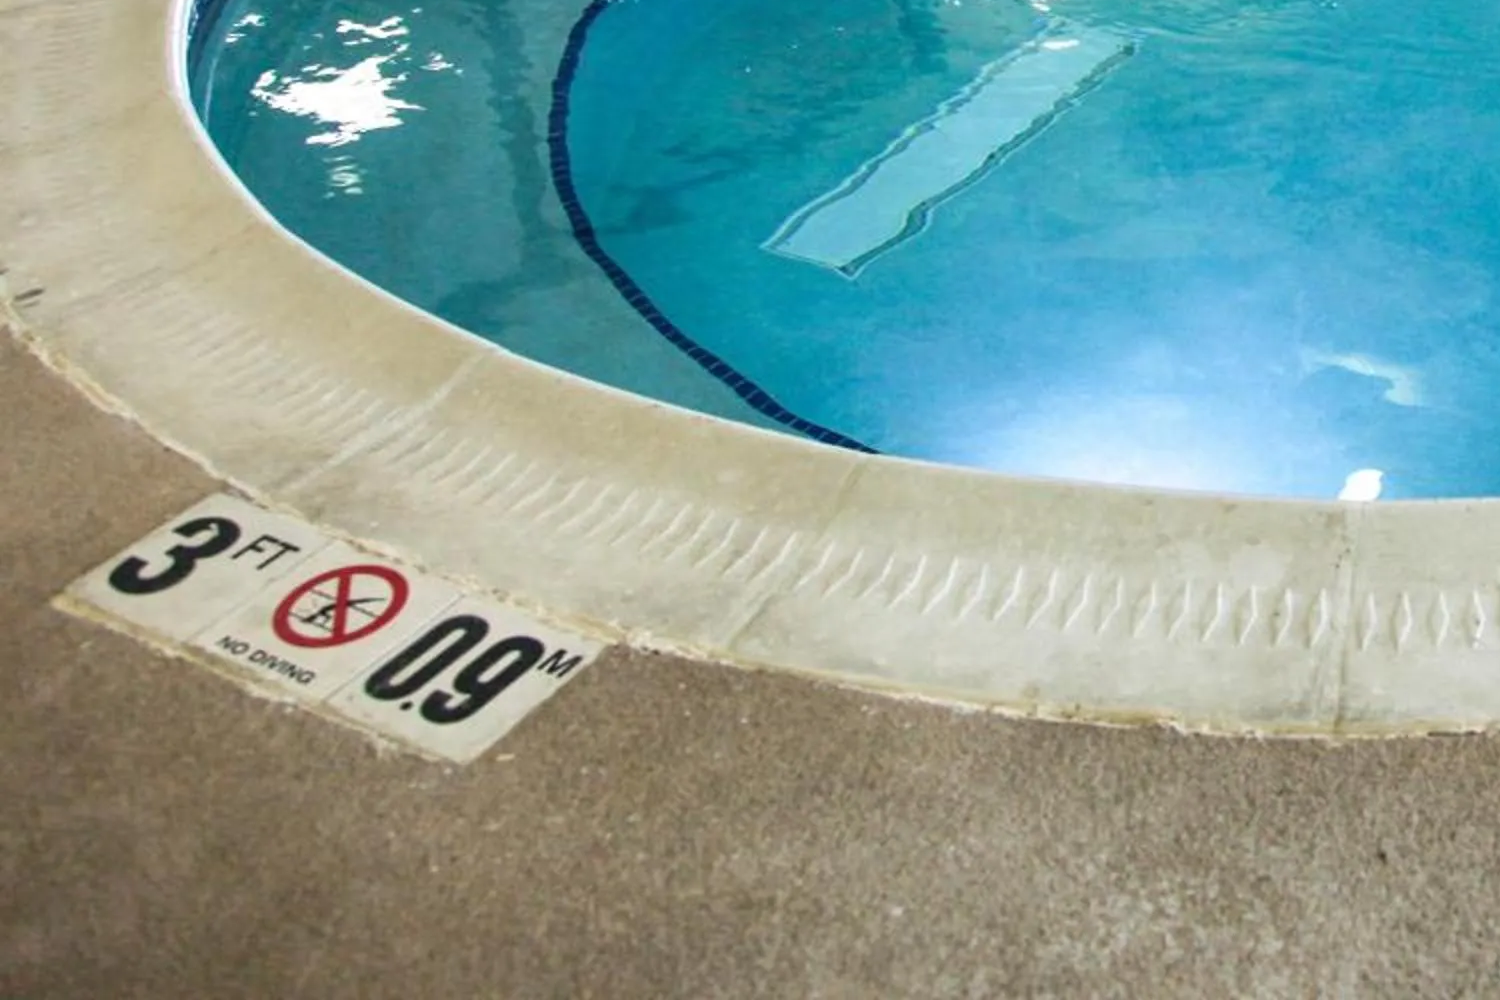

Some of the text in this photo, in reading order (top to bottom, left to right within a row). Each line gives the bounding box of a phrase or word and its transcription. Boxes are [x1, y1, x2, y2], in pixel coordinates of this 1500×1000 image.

[108, 516, 584, 725] 3 FT 0.9 M
[216, 635, 317, 685] NO DIVING
